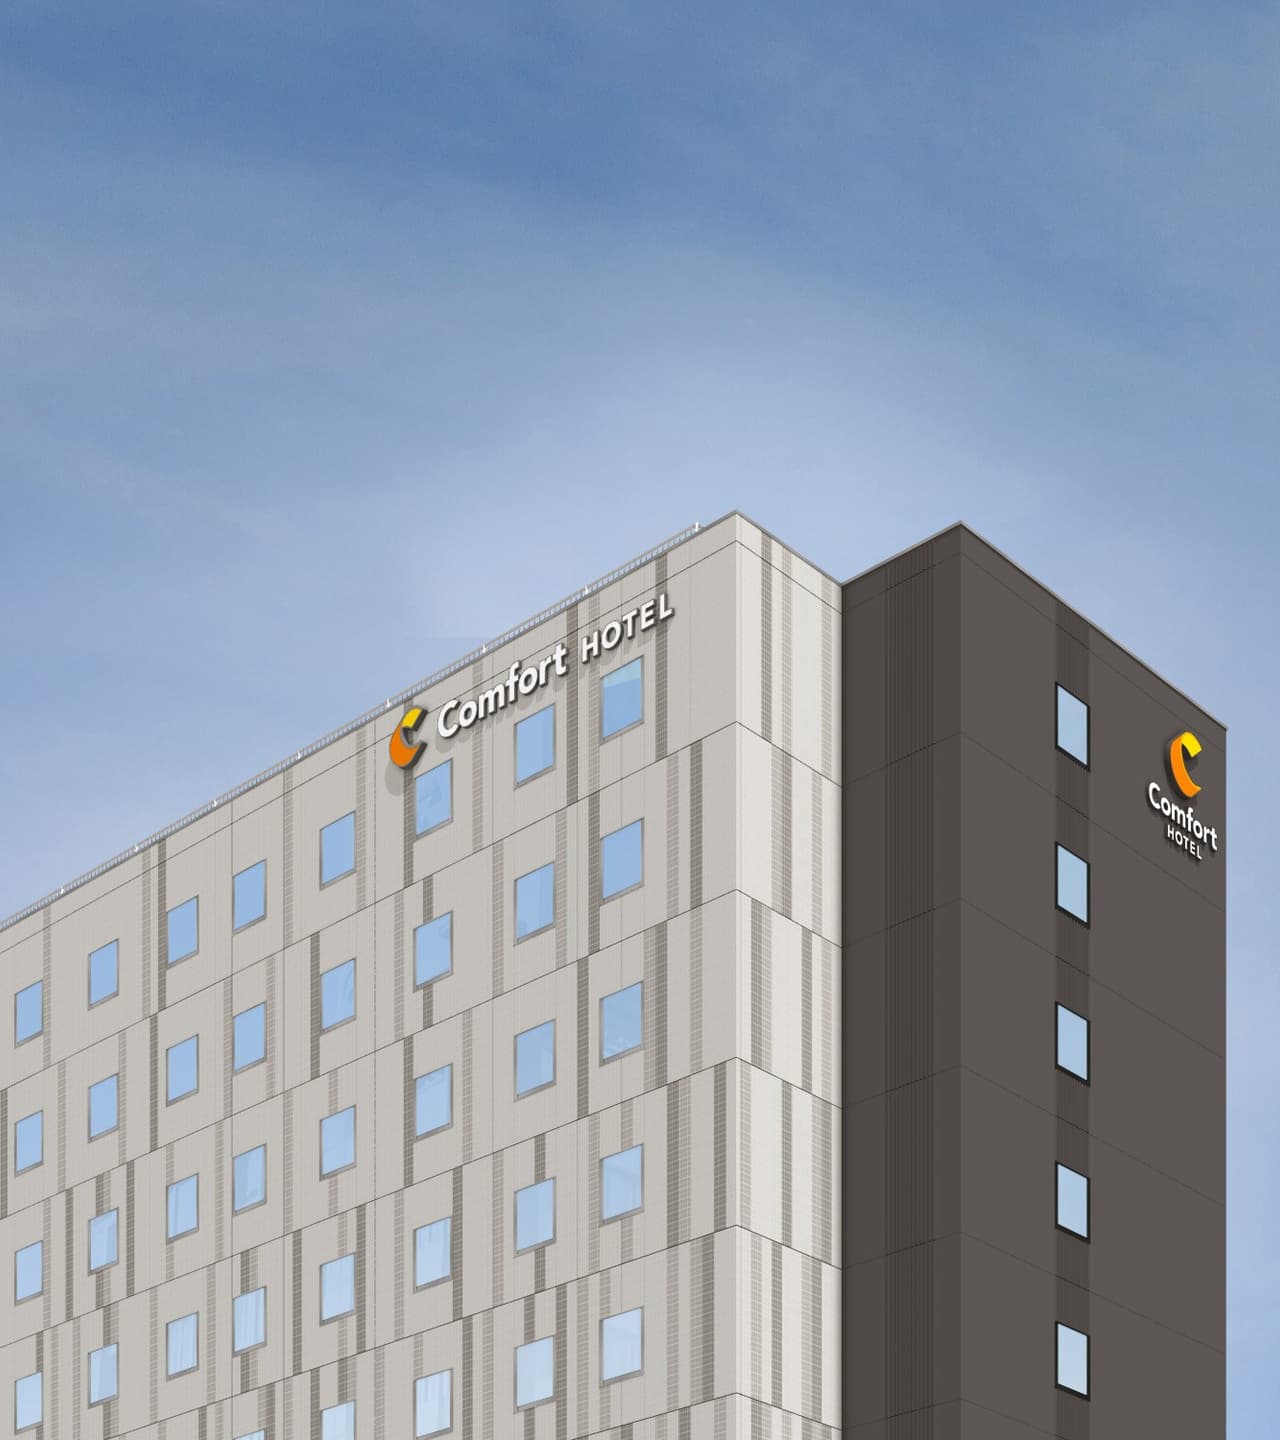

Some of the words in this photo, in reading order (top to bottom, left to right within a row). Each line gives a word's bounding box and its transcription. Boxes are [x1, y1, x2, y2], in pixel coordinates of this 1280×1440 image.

[437, 642, 568, 739] Comfort
[581, 593, 674, 663] HOTEL
[1148, 782, 1218, 851] Comfort
[1167, 824, 1202, 860] HOTEL
